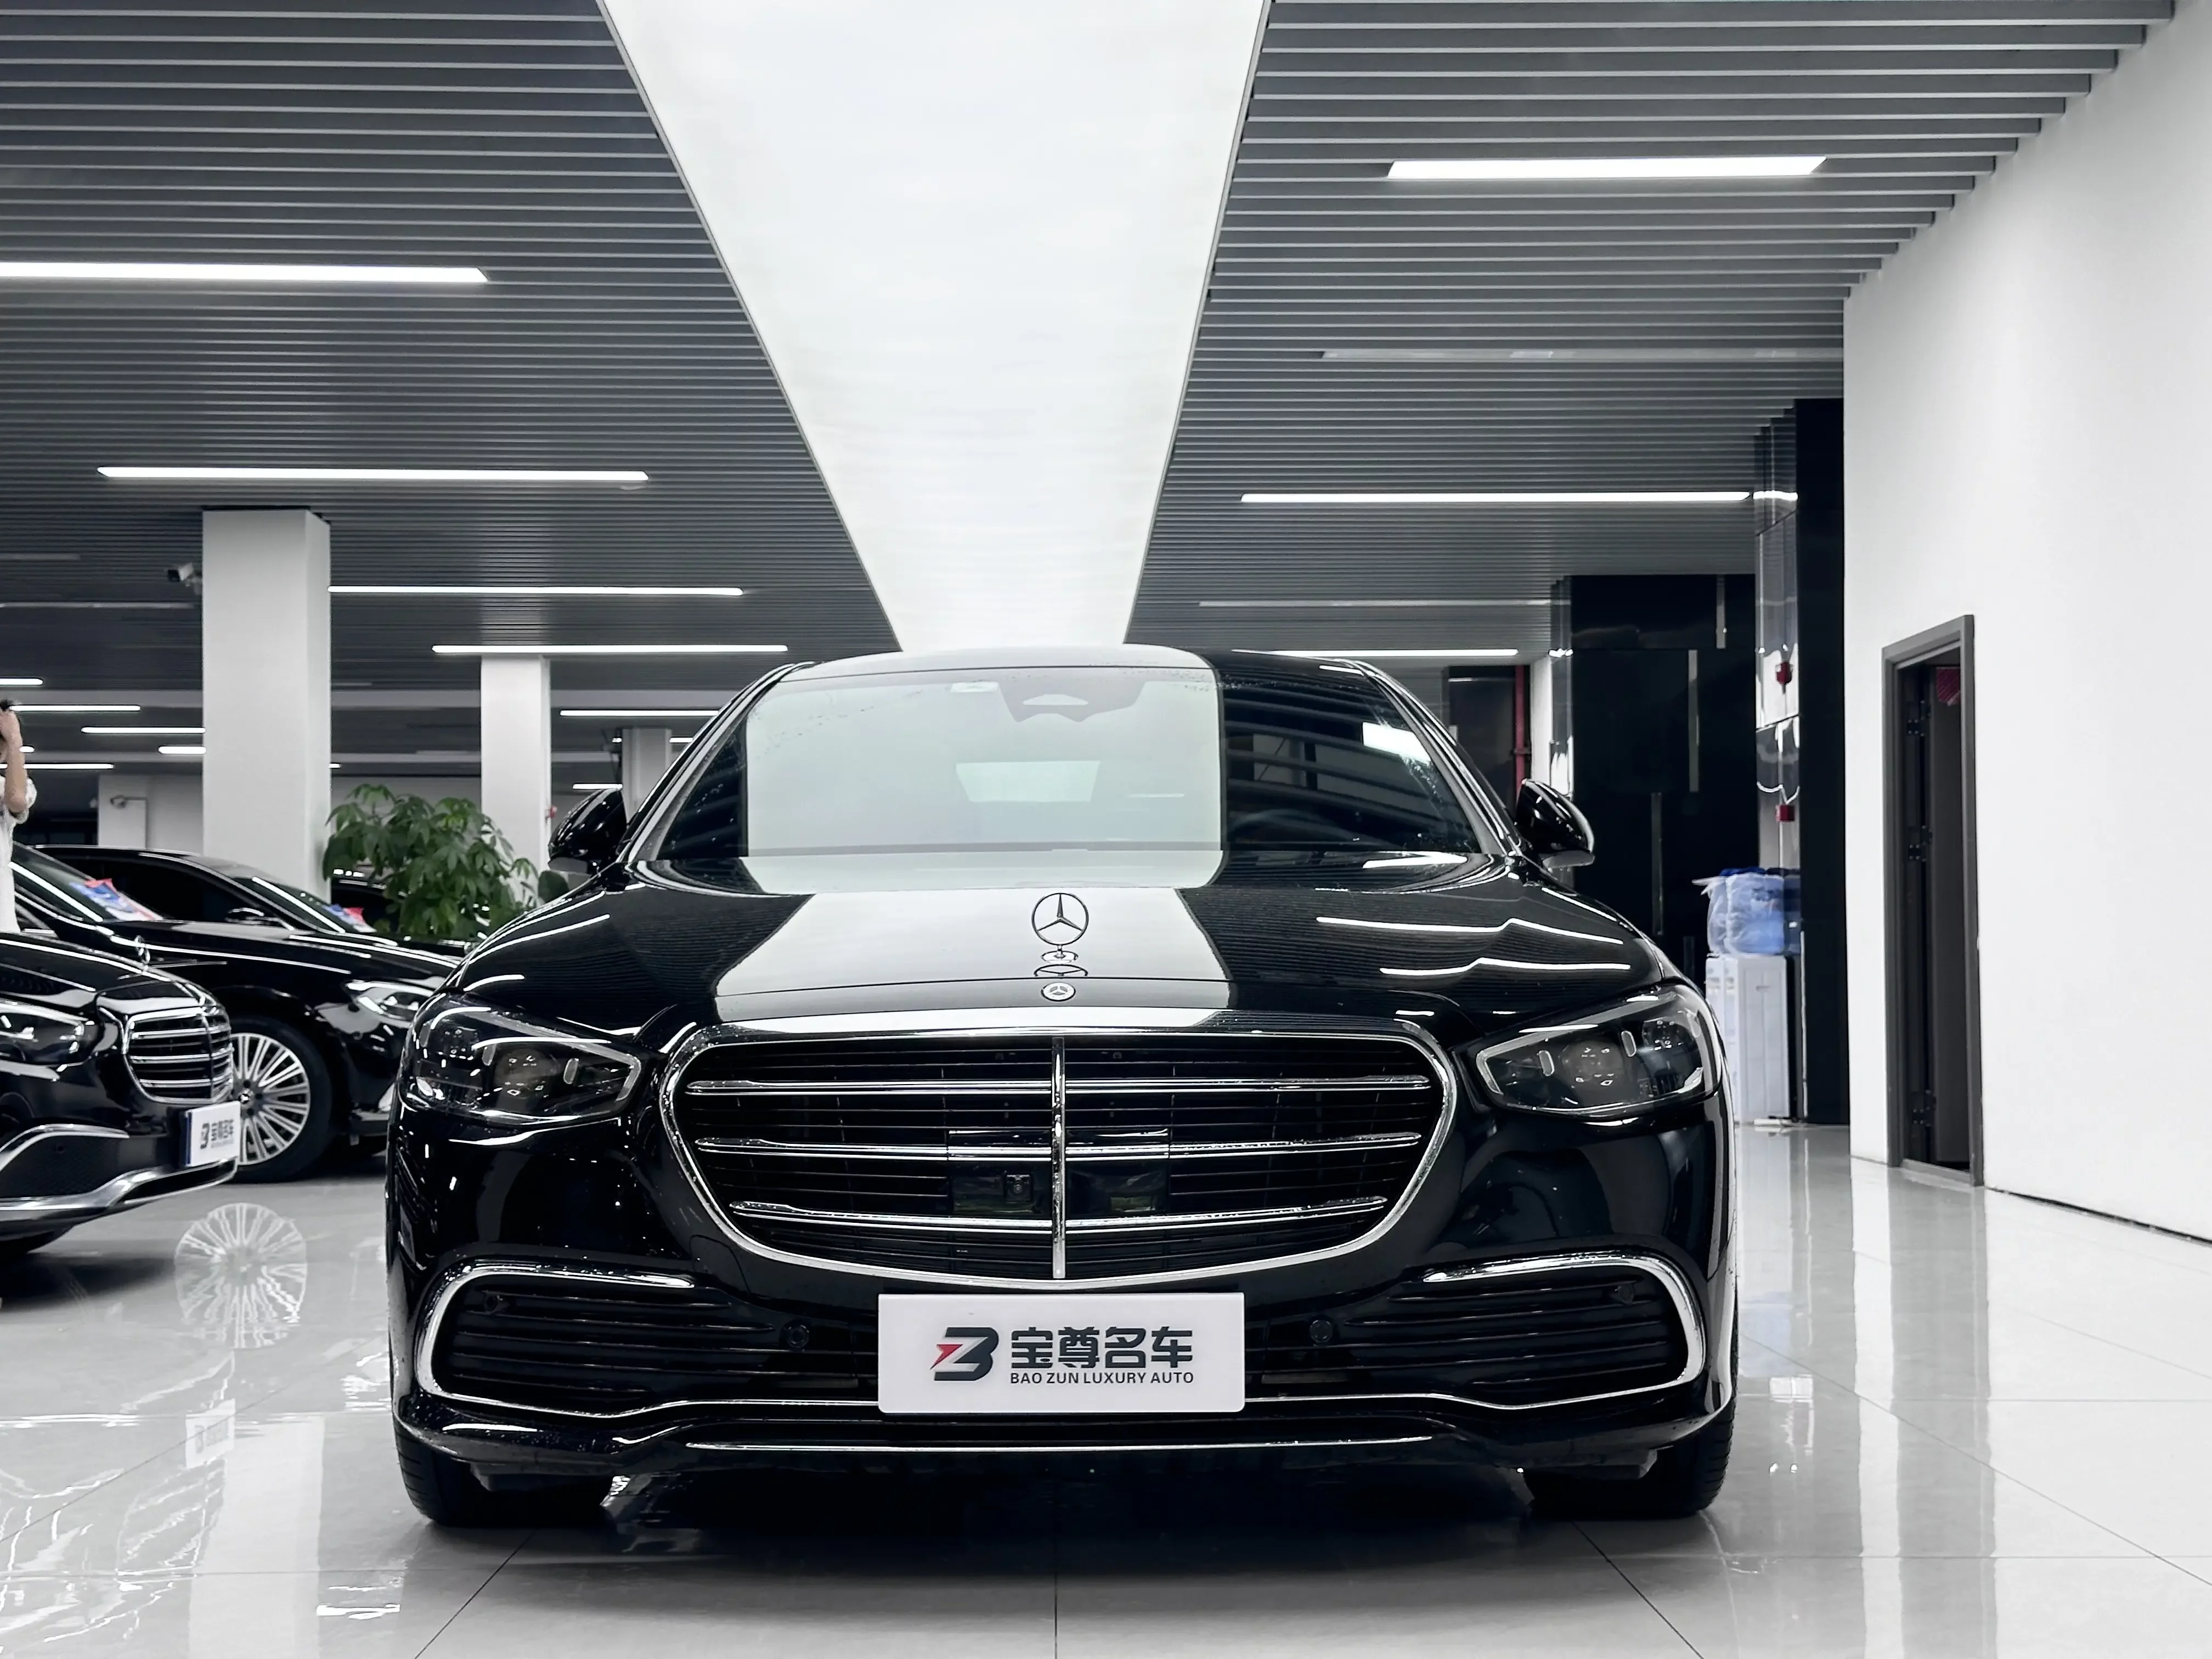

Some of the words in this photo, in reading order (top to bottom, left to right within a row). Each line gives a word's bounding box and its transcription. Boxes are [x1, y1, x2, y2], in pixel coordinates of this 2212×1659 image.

[1011, 1326, 1193, 1369] 宝尊名车
[1010, 1372, 1042, 1384] BAO
[1046, 1372, 1079, 1384] ZUN
[1084, 1372, 1147, 1384] LUXURY
[1150, 1372, 1194, 1384] AUTO
